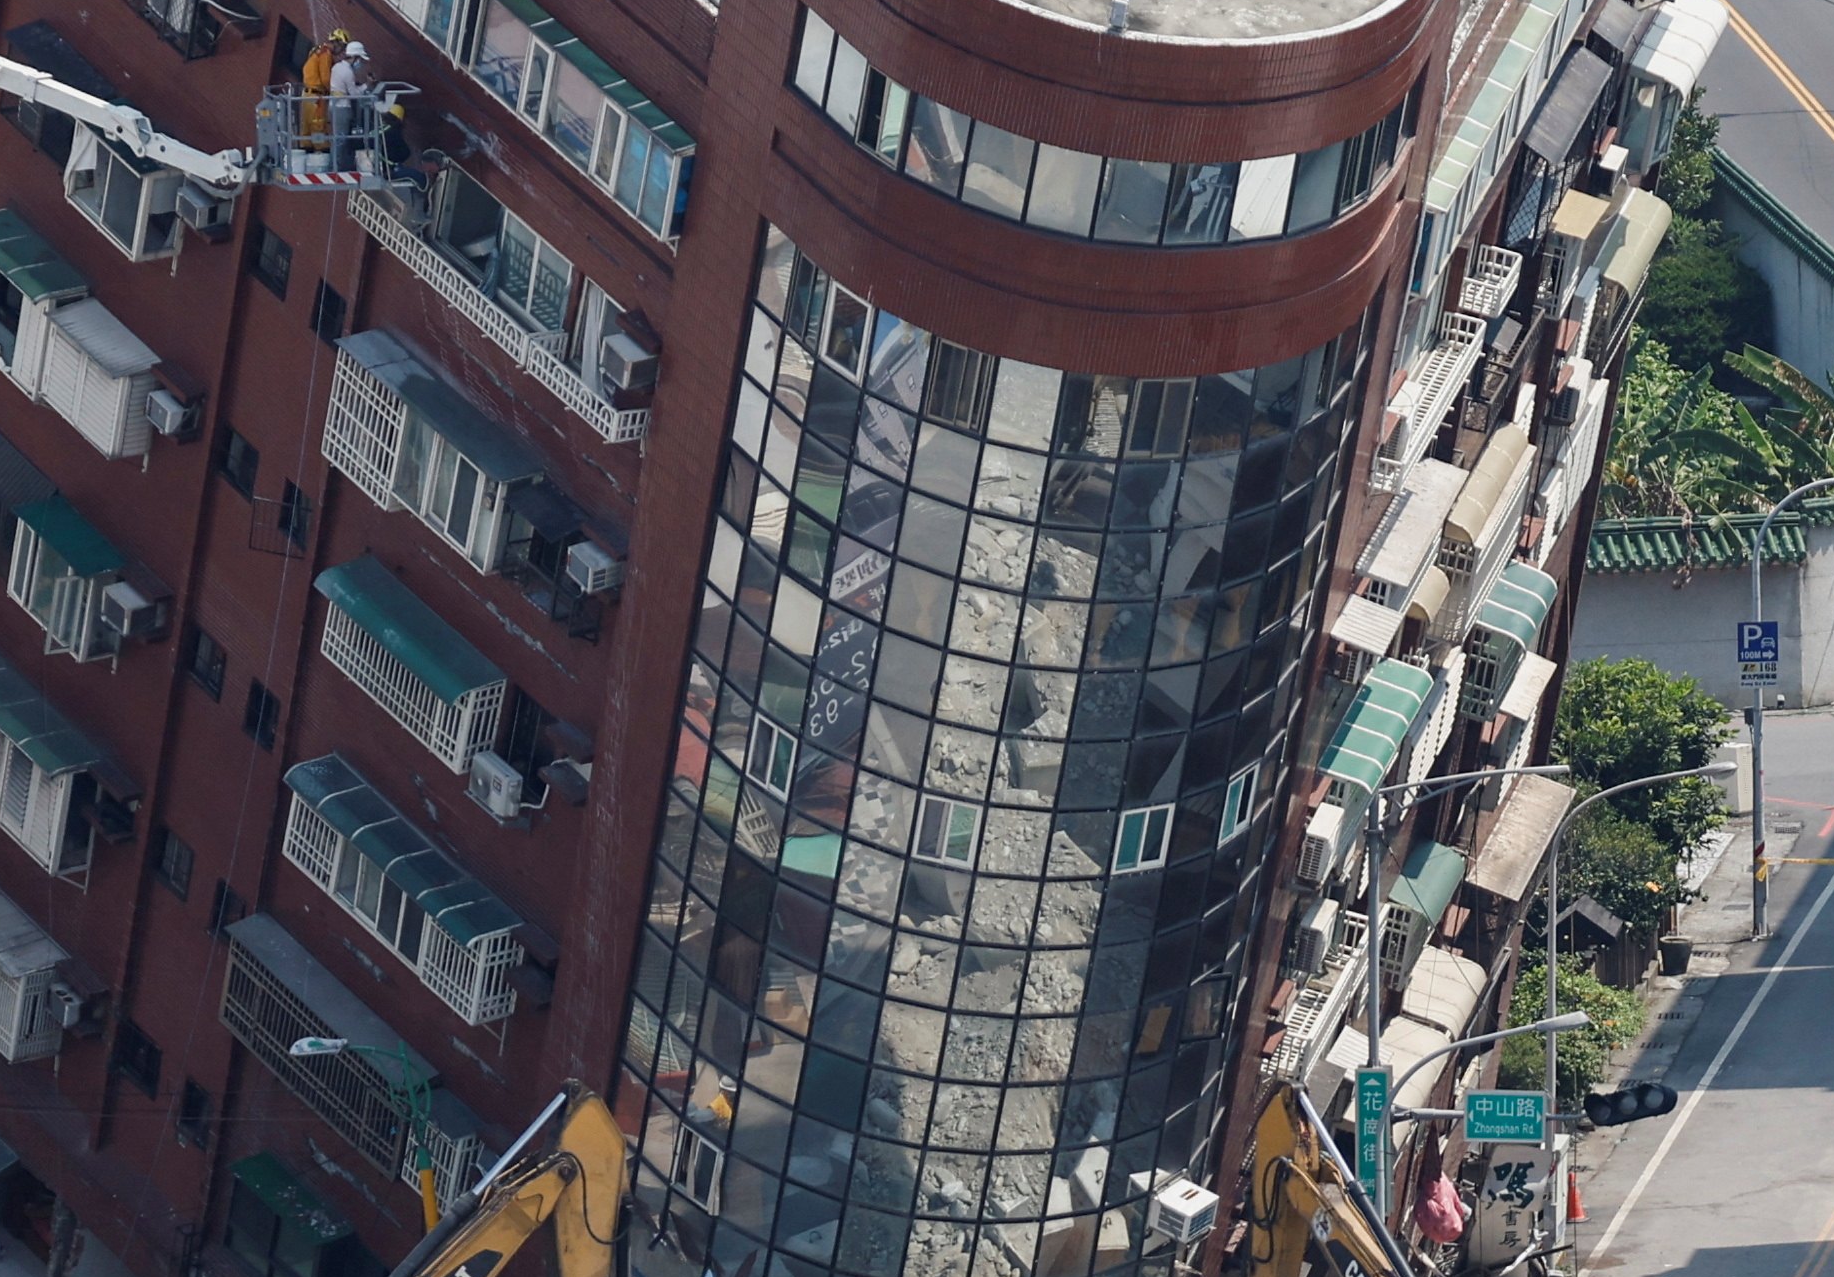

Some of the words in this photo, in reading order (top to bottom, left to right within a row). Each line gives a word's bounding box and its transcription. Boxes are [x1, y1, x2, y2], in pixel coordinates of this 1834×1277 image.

[1743, 625, 1762, 649] P
[1475, 1097, 1536, 1119] 中山路
[1474, 1123, 1519, 1137] Zhongshan
